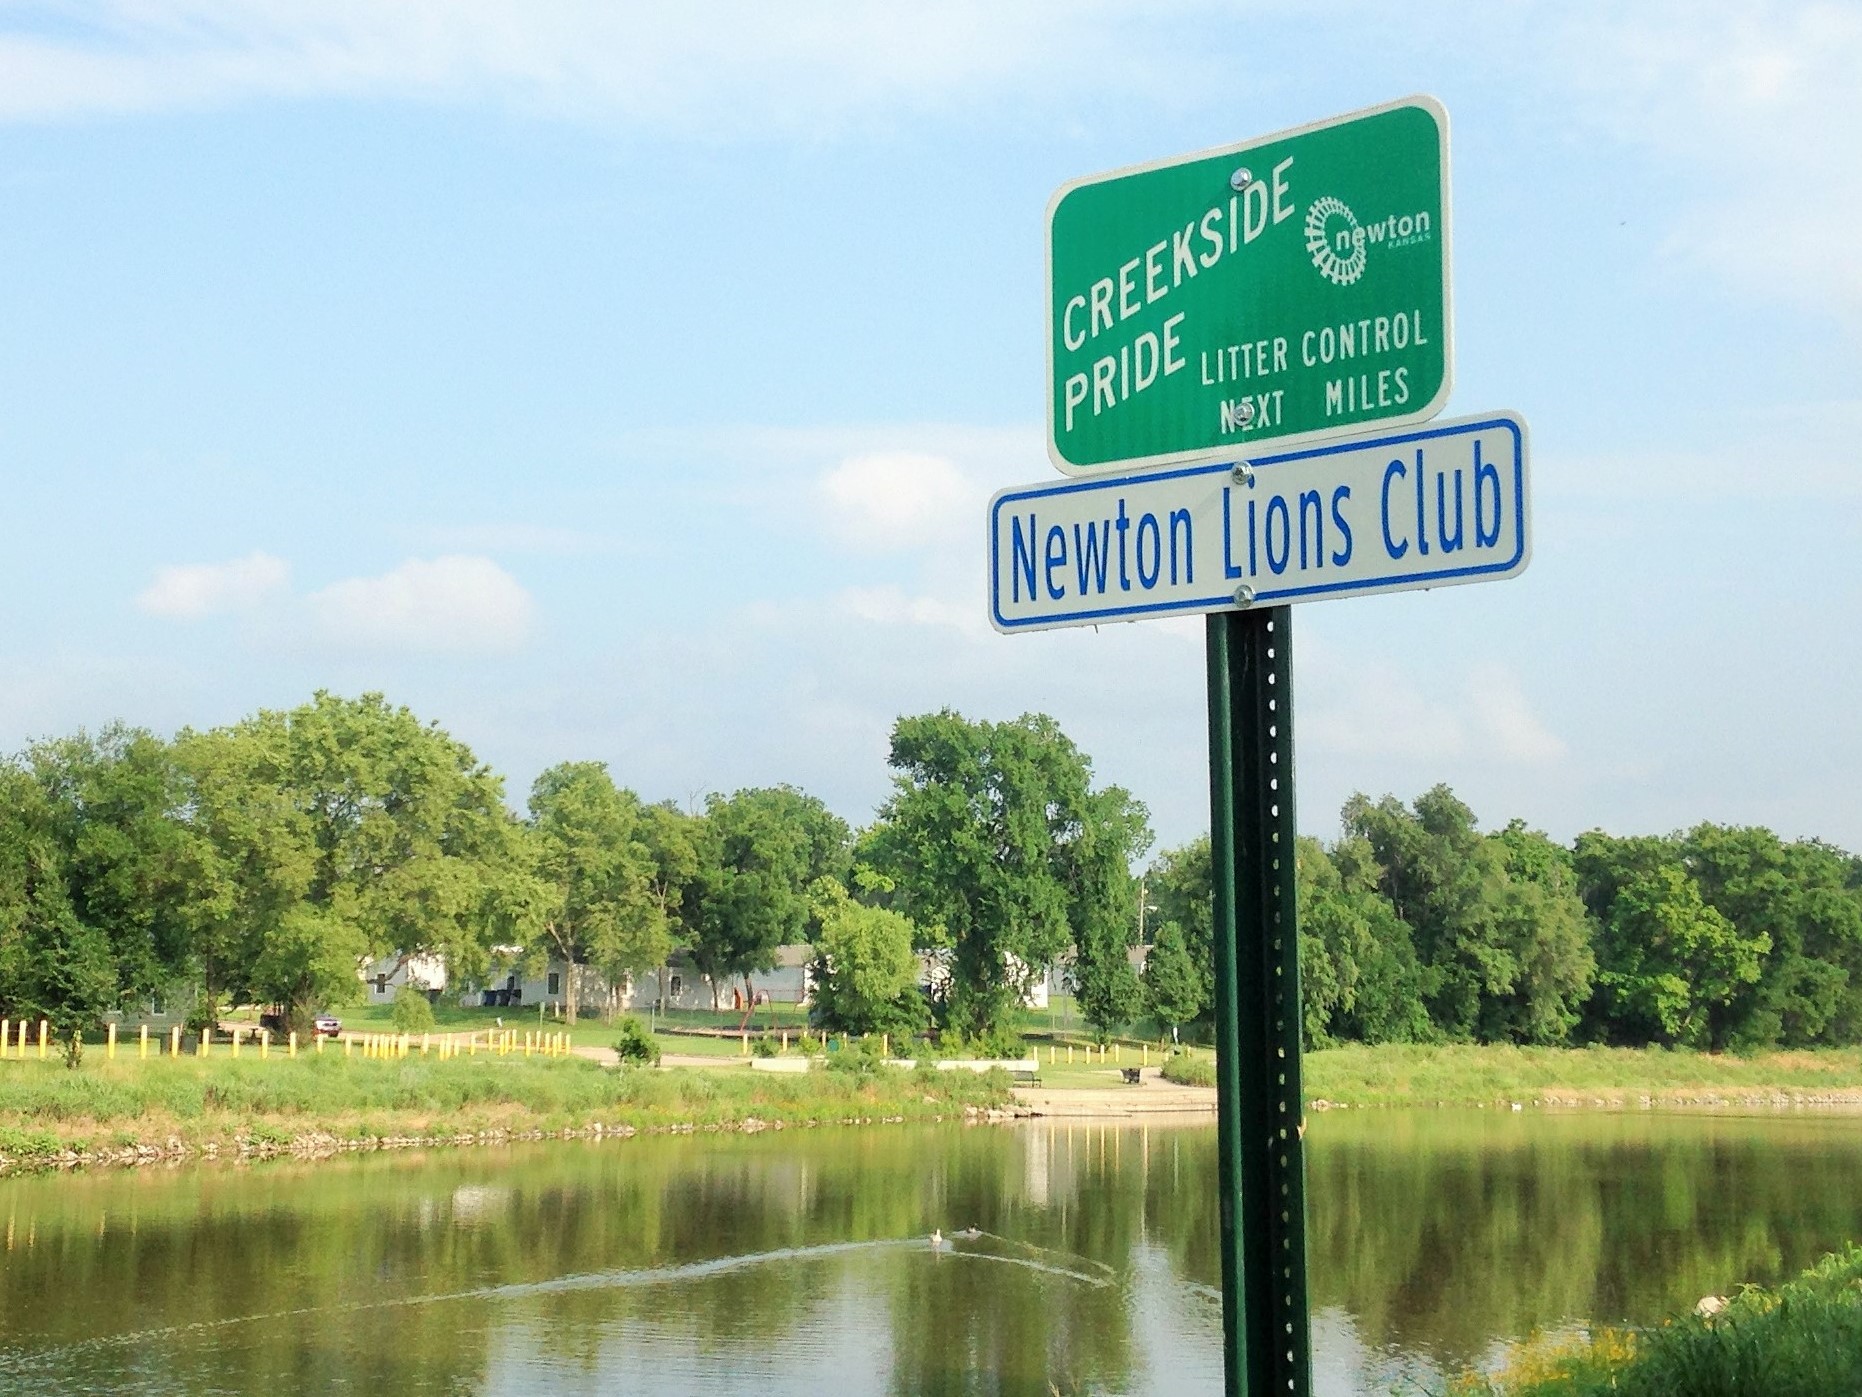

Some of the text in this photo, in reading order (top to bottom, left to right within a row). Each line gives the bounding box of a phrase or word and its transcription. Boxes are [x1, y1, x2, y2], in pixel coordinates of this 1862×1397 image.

[1064, 156, 1295, 352] CREEKSIDE
[1336, 211, 1430, 251] newton
[1387, 232, 1431, 249] KANSAS
[1065, 312, 1186, 432] PRIDE
[1201, 309, 1428, 385] LITTER CONTROL
[1325, 367, 1409, 416] MILES
[1012, 440, 1502, 603] Newton Lions Club
